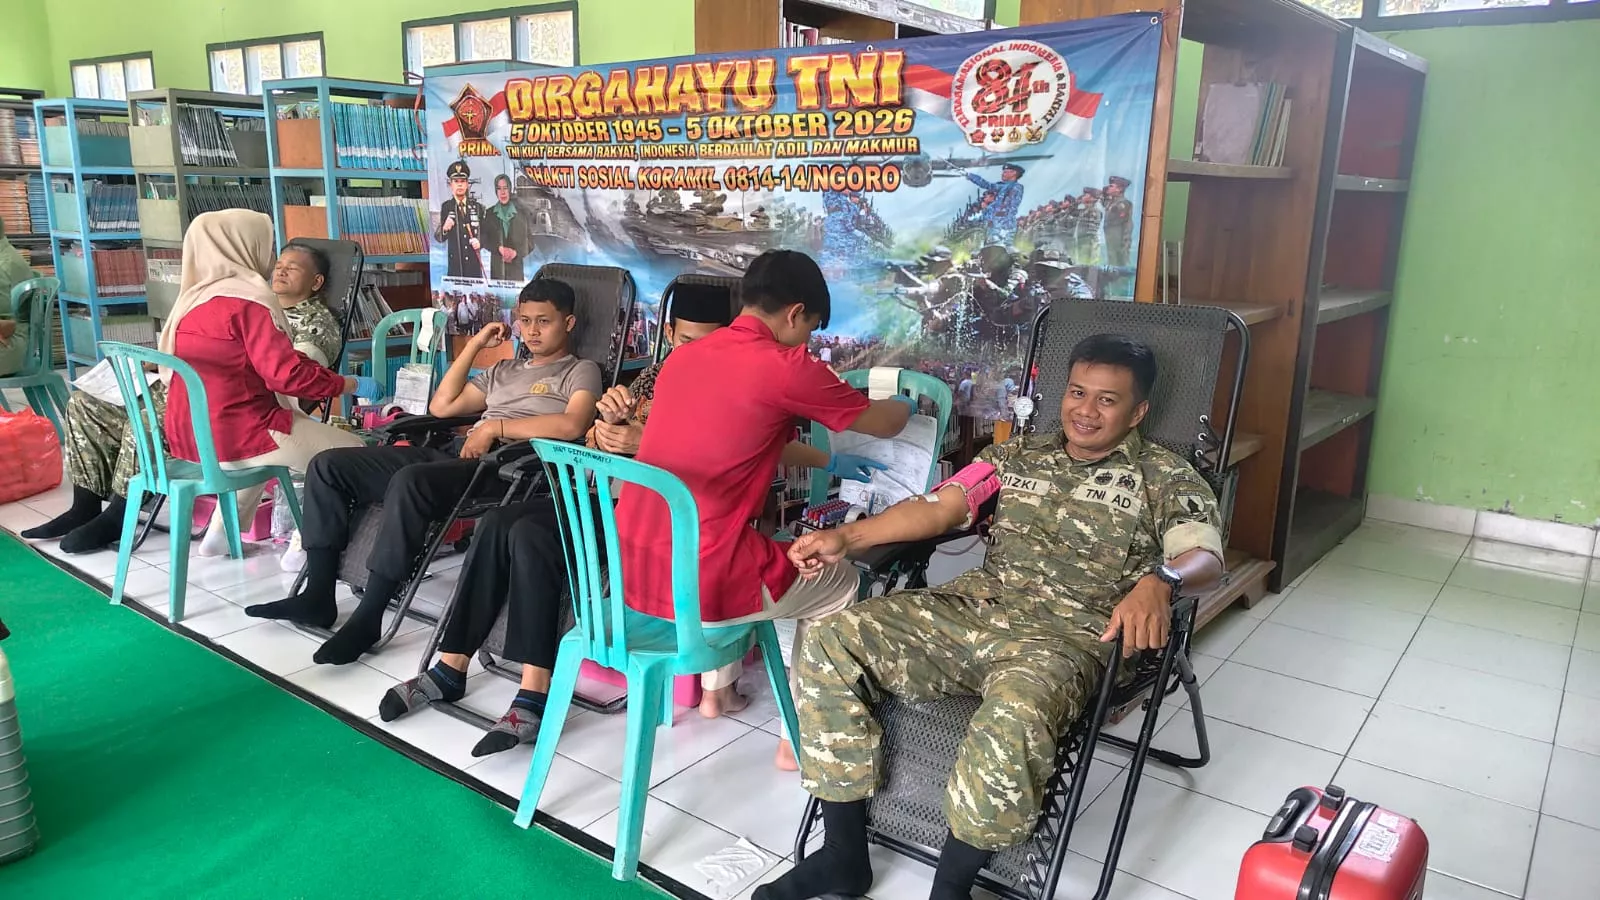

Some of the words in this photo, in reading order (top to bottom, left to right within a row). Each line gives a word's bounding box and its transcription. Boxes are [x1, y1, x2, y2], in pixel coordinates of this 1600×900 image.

[504, 57, 776, 122] DIRGAHAYU
[788, 51, 904, 109] TNI
[511, 123, 525, 143] 5
[526, 121, 610, 144] OKTOBER
[612, 118, 663, 142] 1945
[686, 116, 704, 141] 5
[706, 112, 830, 140] OKTOBER
[834, 108, 917, 138] 2026
[976, 113, 1033, 128] PRIMA
[506, 145, 521, 159] TNI
[521, 145, 545, 160] KUAT
[546, 145, 594, 160] BERSAMA
[594, 145, 639, 161] RAKYAT,
[640, 144, 697, 159] INDONESIA
[699, 142, 773, 160] BERDAULAT
[775, 141, 809, 158] ADIL
[810, 140, 844, 157] DAN
[845, 137, 921, 156] MAKMUR
[578, 165, 635, 190] SOSIAL
[637, 165, 721, 191] KORAMIL
[723, 164, 901, 192] 0814-14/NGORO
[1086, 488, 1106, 501] TNI
[1111, 494, 1131, 509] AD
